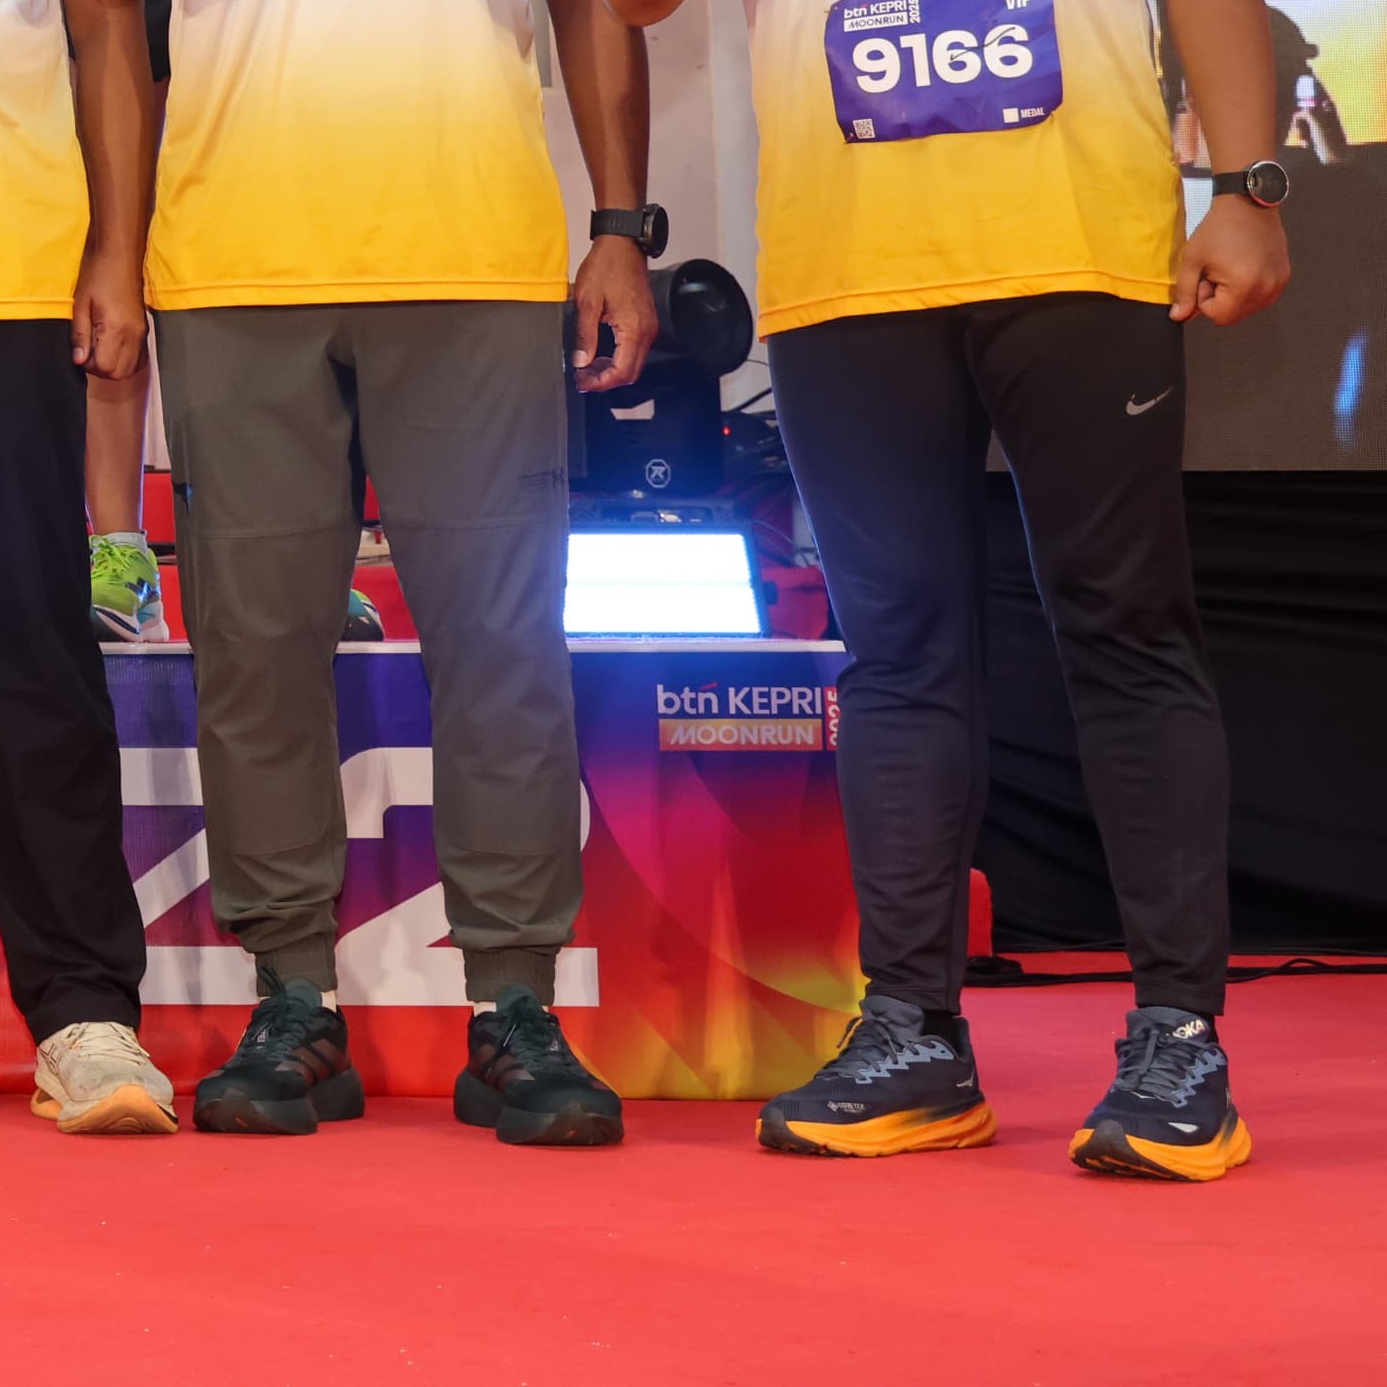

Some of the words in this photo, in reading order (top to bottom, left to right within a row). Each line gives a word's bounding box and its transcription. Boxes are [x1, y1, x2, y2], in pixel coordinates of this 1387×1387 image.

[844, 3, 867, 19] btn
[870, 0, 907, 15] KEPRI
[848, 15, 904, 29] MOONRUN
[853, 24, 1033, 93] 9166
[1021, 107, 1045, 118] MEDAL
[656, 682, 718, 714] btn
[729, 687, 822, 714] KEPRI
[670, 725, 814, 745] MOONRUN
[1172, 1019, 1205, 1039] OKA
